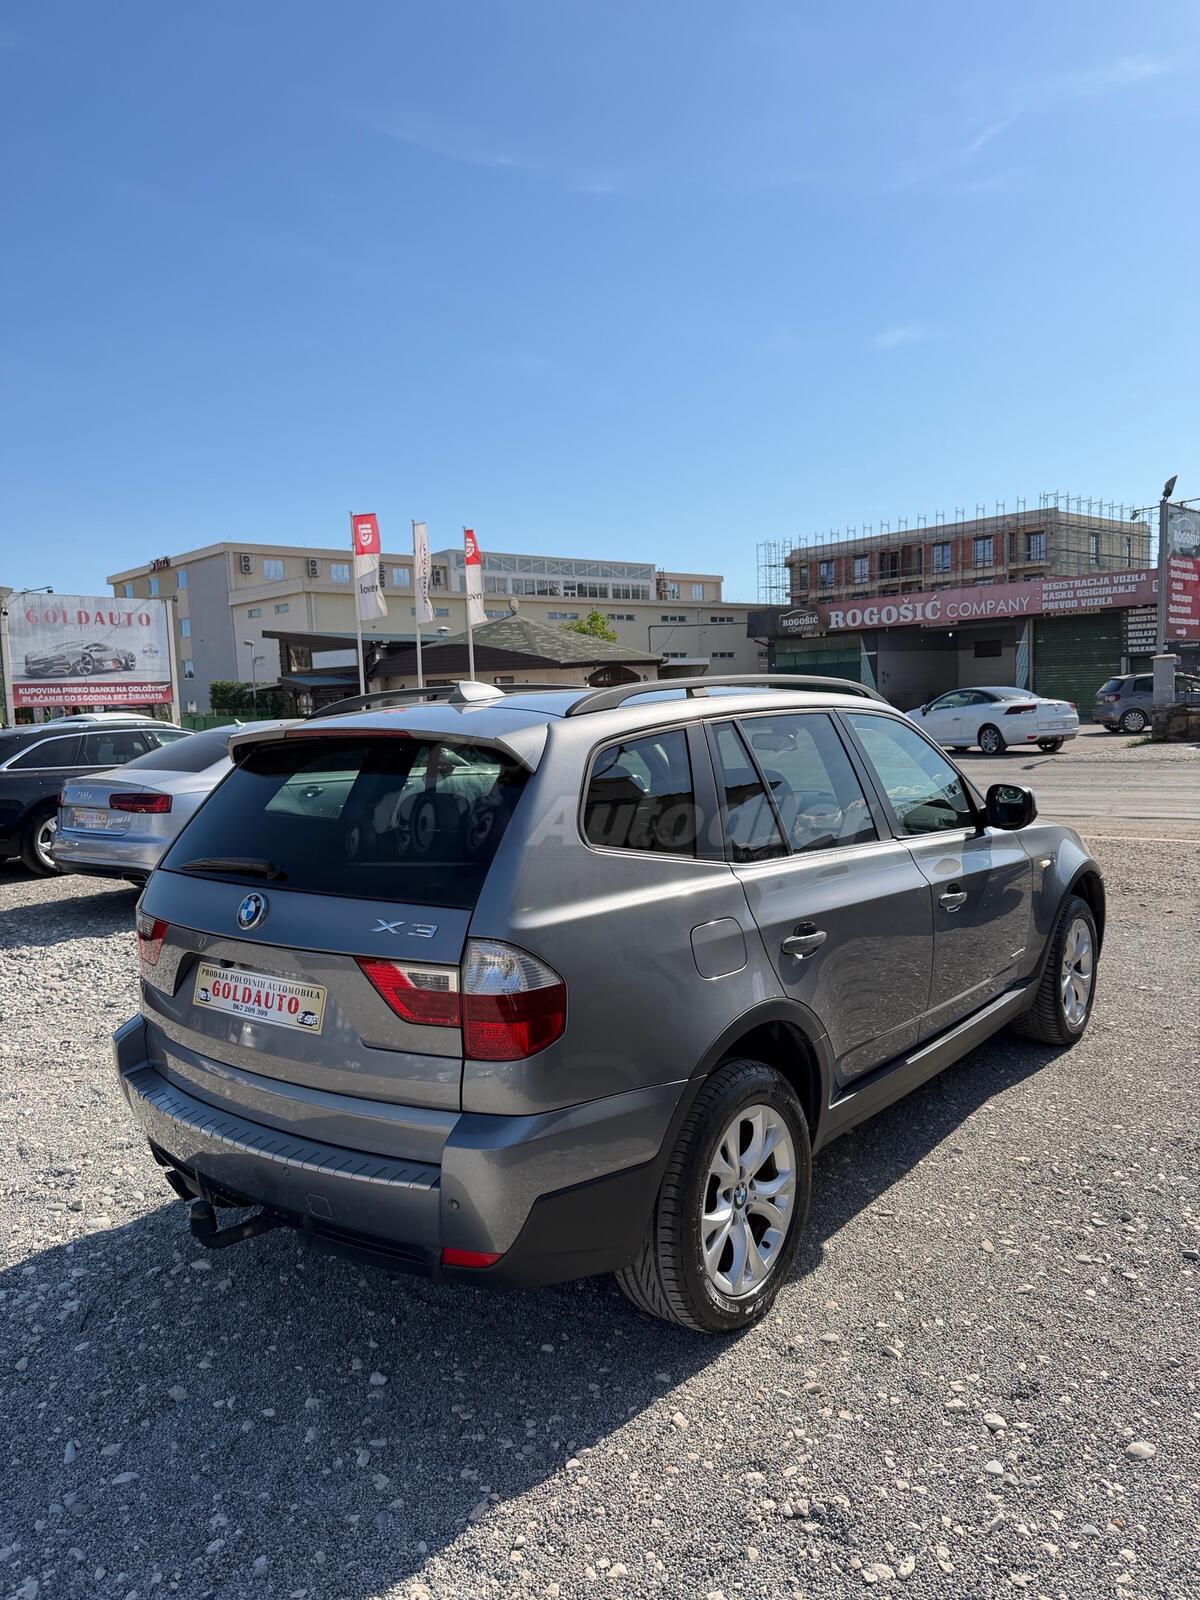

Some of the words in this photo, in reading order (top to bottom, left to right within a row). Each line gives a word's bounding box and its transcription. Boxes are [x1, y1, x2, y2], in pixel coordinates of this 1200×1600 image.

[1042, 577, 1109, 591] REGISTRACIJA
[1112, 573, 1147, 584] VOZILA
[1042, 589, 1073, 601] KASKO
[1076, 584, 1137, 597] OSIGURANJE
[1081, 596, 1113, 607] VOZILA
[26, 608, 151, 626] GOLDAUTO
[829, 595, 941, 629] ROGOŠIĆ
[946, 596, 1030, 617] COMPANY
[788, 625, 814, 633] COMPANY
[19, 687, 62, 695] KUPOVINA
[63, 686, 89, 694] PREKO
[22, 695, 64, 703] PLAĆANJE
[83, 694, 112, 702] GODINA
[201, 968, 229, 981] PRODAJA
[230, 974, 266, 989] POLOVNIH
[267, 981, 321, 1000] AUTOMOBILA
[211, 980, 300, 1014] GOLDAUTO
[232, 1003, 243, 1012] 067
[256, 1007, 269, 1017] 309
